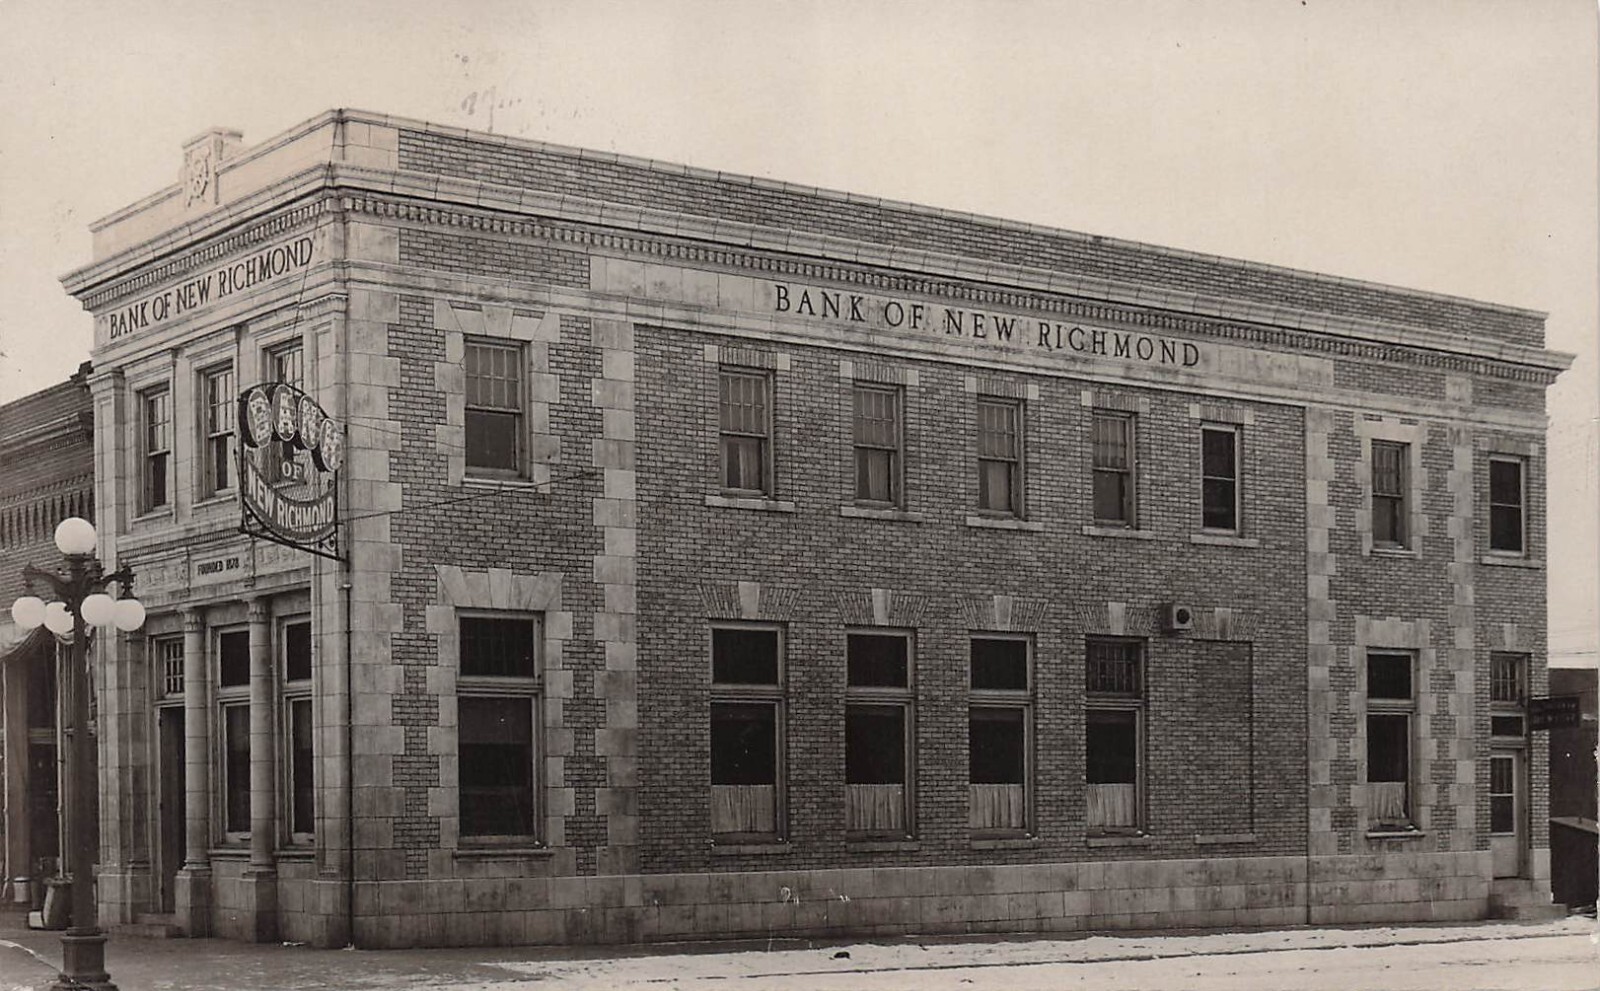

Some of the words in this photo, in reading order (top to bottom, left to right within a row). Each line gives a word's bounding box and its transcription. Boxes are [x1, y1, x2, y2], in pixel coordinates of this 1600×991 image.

[110, 301, 149, 339] BANK
[152, 292, 172, 322] OF
[176, 275, 212, 314] NEW
[218, 237, 313, 298] RICHMOND
[775, 284, 865, 322] BANK
[884, 301, 924, 329] OF
[945, 309, 1017, 341] NEW
[1037, 321, 1199, 367] RICHMOND
[249, 391, 342, 470] BANK
[282, 461, 303, 479] OF
[247, 463, 275, 518] NEW
[277, 496, 334, 533] RICHMOND
